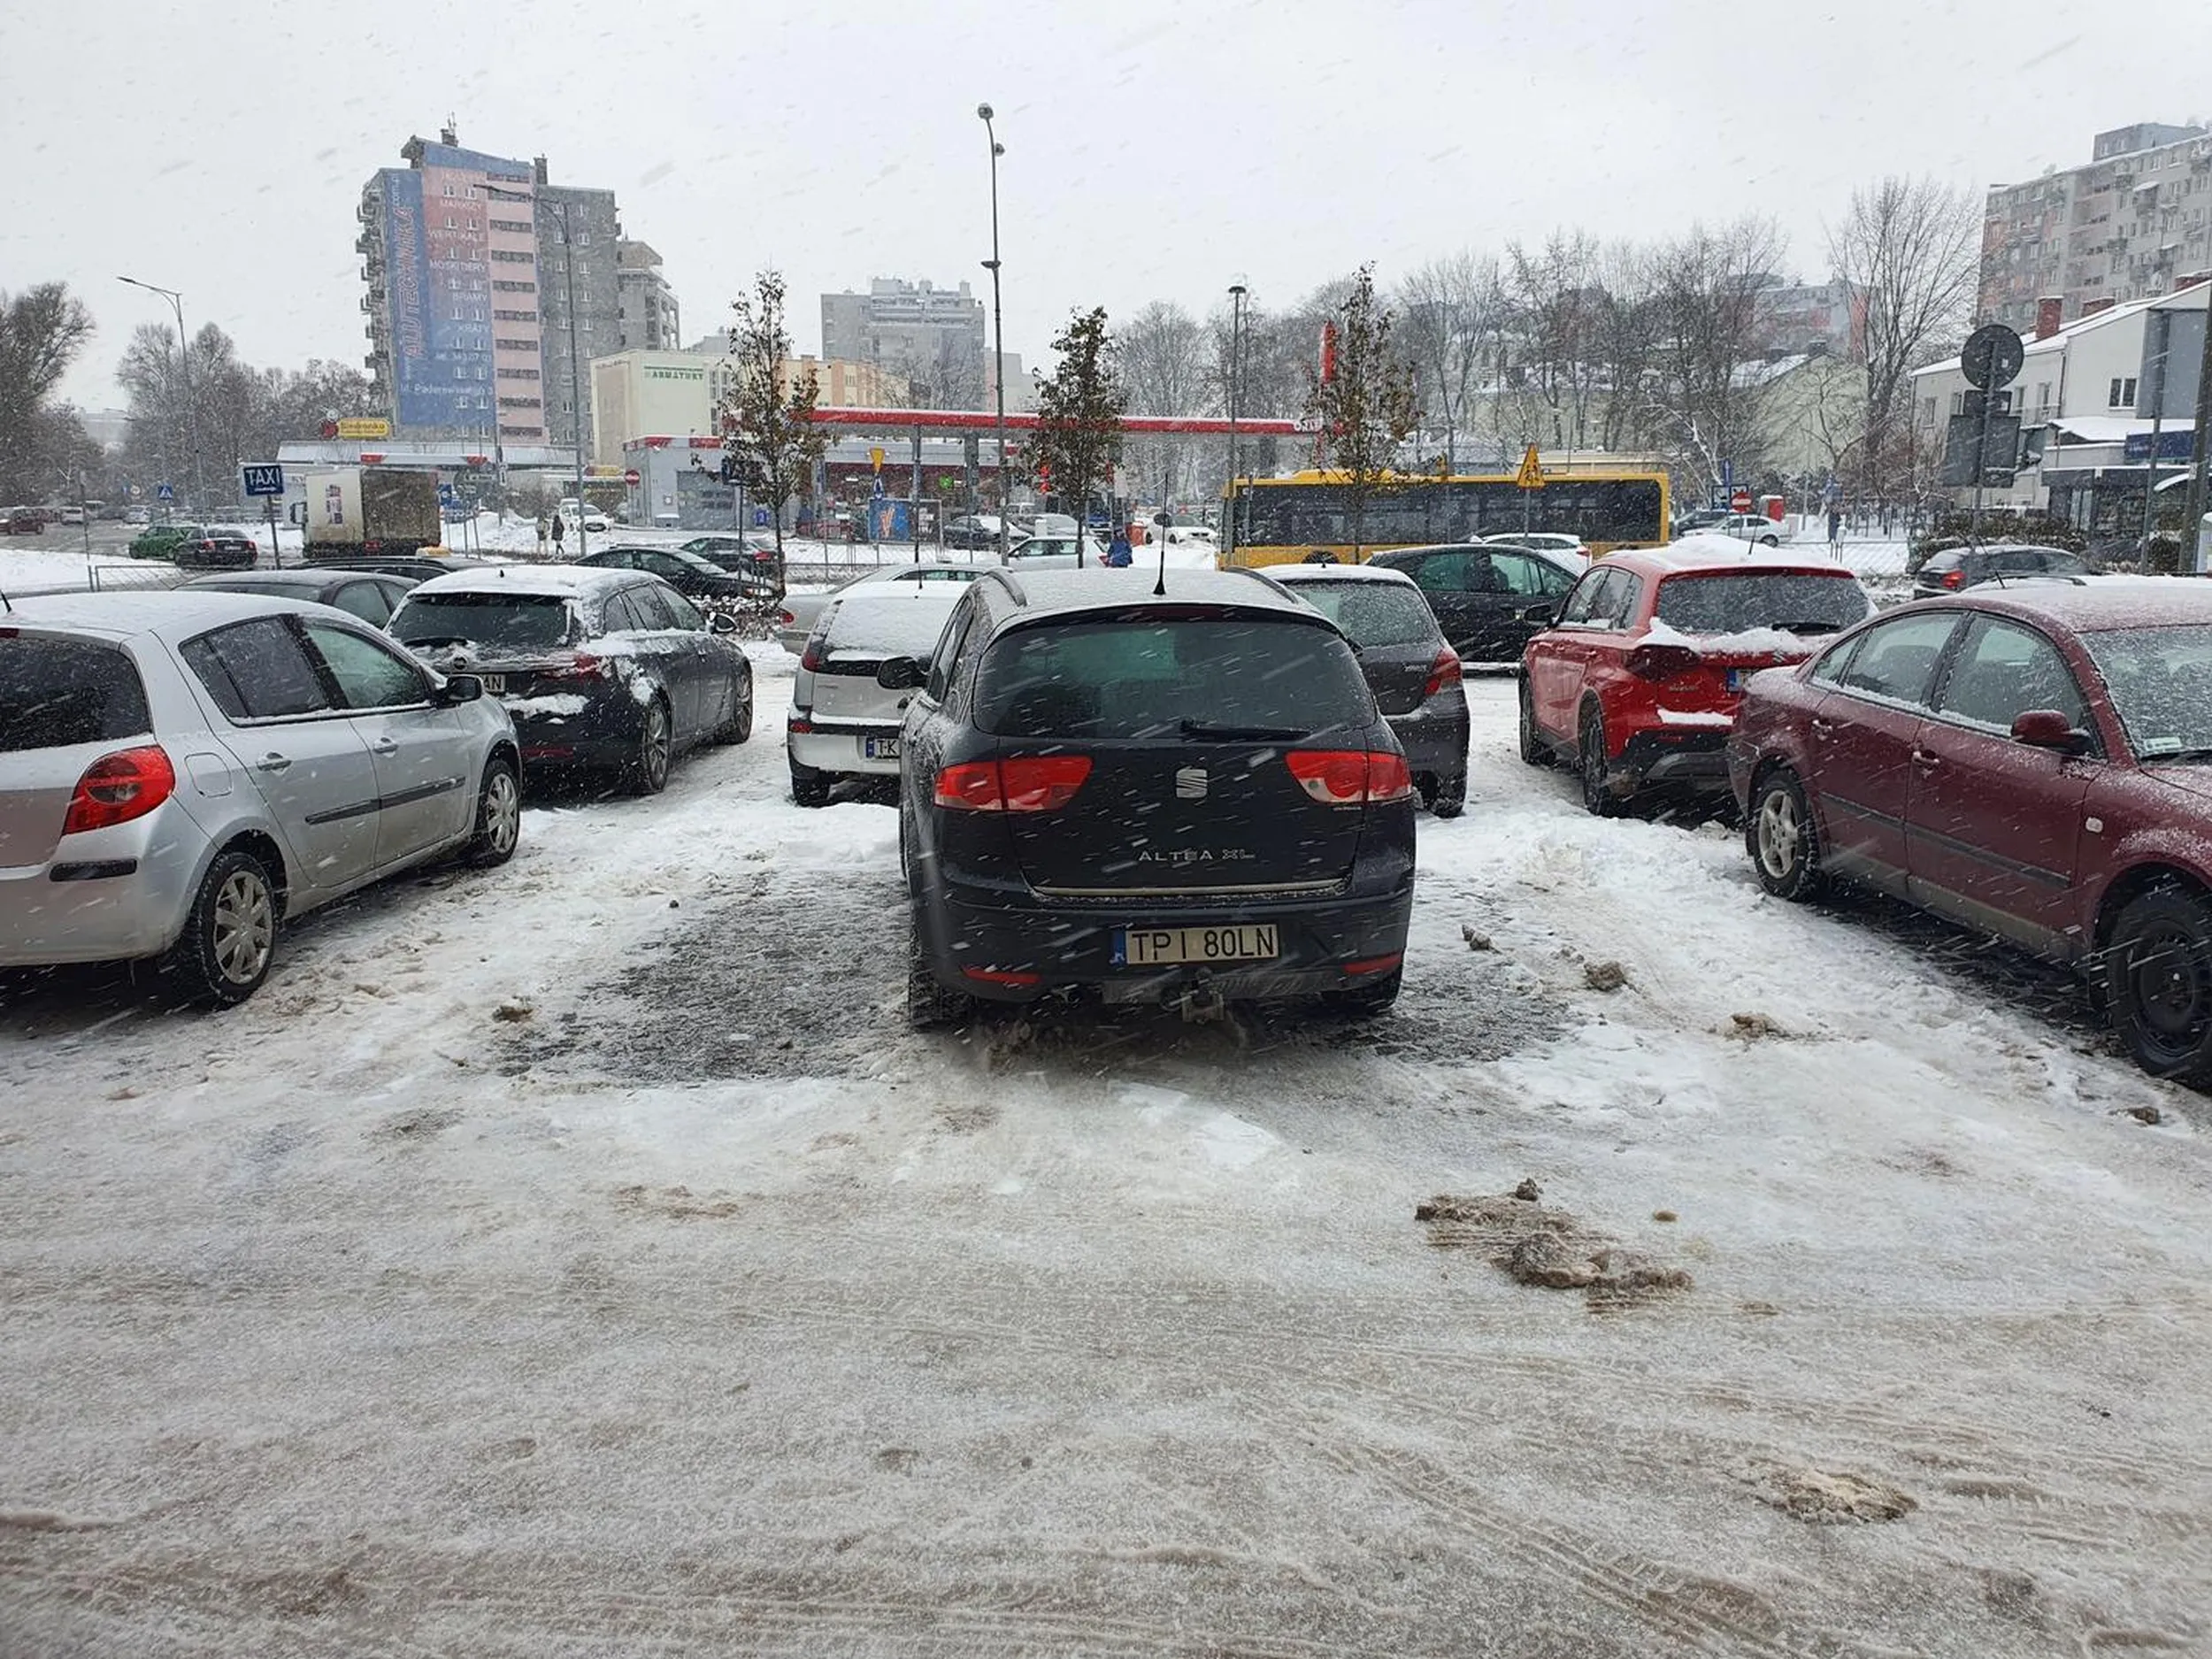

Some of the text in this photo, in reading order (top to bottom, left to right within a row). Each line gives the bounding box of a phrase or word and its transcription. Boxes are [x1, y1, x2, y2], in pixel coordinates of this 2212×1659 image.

[246, 468, 280, 486] TAXI
[1139, 849, 1255, 862] ALTEA XL
[1132, 930, 1187, 961] TPI
[1204, 926, 1274, 957] 80LN
